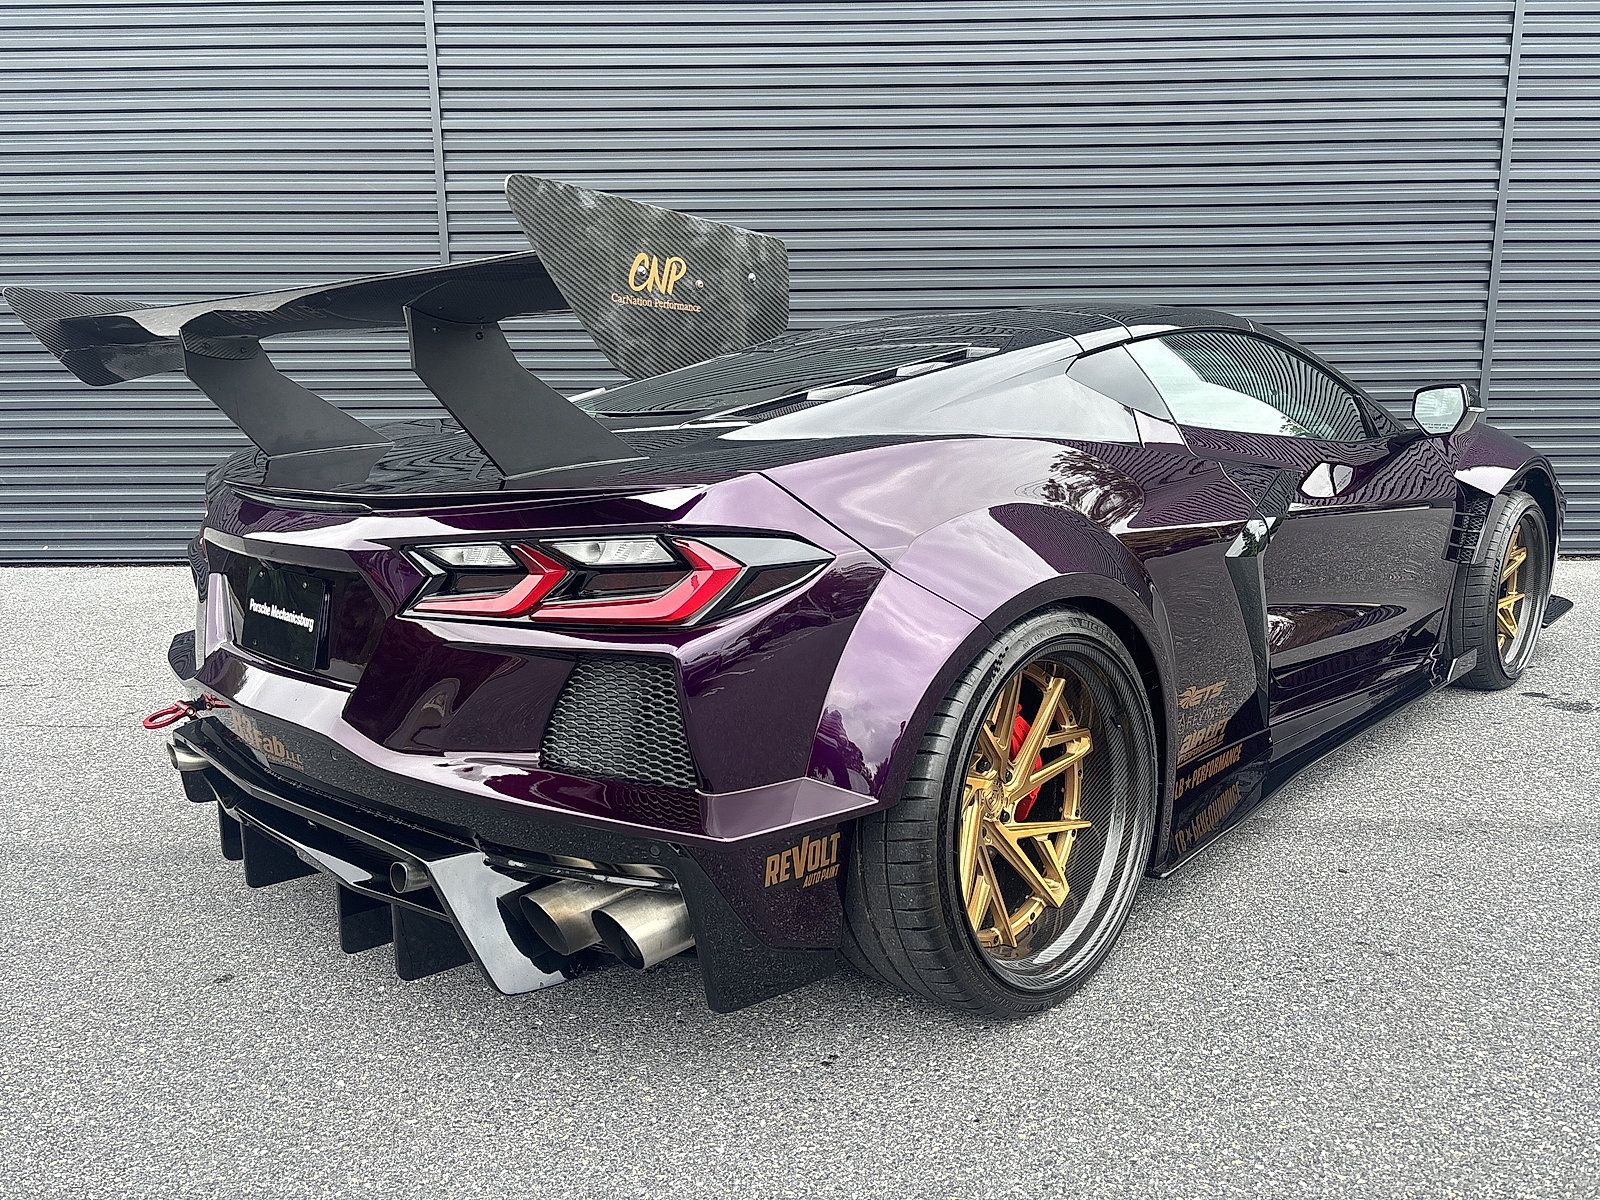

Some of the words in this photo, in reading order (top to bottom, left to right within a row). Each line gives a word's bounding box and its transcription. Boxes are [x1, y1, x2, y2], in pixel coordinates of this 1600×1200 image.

[628, 252, 687, 295] CNP
[611, 293, 653, 308] CarNation
[654, 299, 701, 313] Performance
[249, 598, 271, 617] Porsche
[270, 604, 315, 633] Mechanicsburg
[1174, 777, 1185, 801] LB
[1191, 743, 1243, 789] PERFORMANCE
[764, 831, 840, 888] REVOLT
[802, 870, 821, 888] AUTO
[820, 863, 840, 882] PAINT
